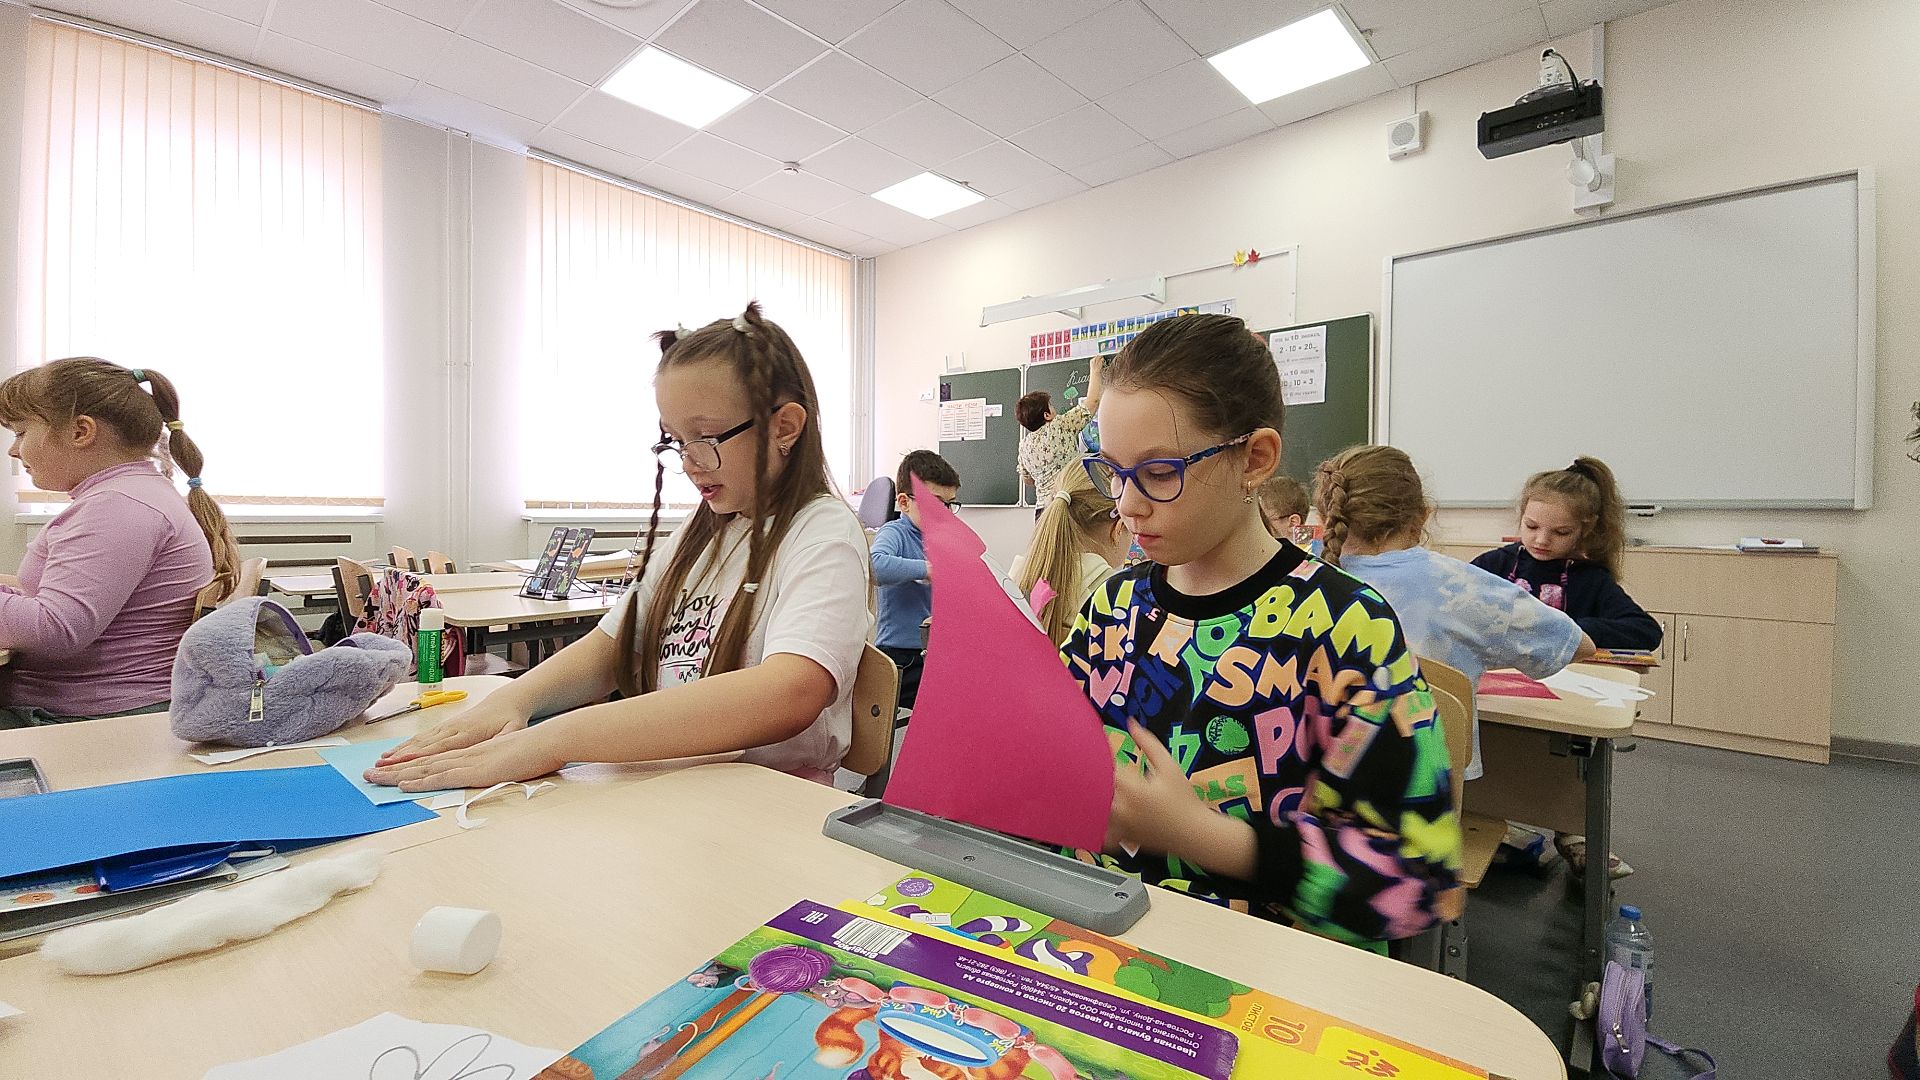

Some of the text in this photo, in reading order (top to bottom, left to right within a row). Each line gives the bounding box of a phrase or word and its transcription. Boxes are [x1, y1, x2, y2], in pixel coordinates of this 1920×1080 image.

[975, 977, 1014, 994] конверте
[1023, 993, 1055, 1009] листов
[1056, 1005, 1068, 1013] 20
[1069, 1008, 1103, 1024] цветов
[1099, 1010, 1144, 1029] типографии
[1103, 1021, 1114, 1029] 10
[1117, 1025, 1152, 1042] бумага
[1264, 1016, 1306, 1044] 10
[1152, 1028, 1200, 1049] Отпечатано
[1153, 1037, 1197, 1058] Цветная
